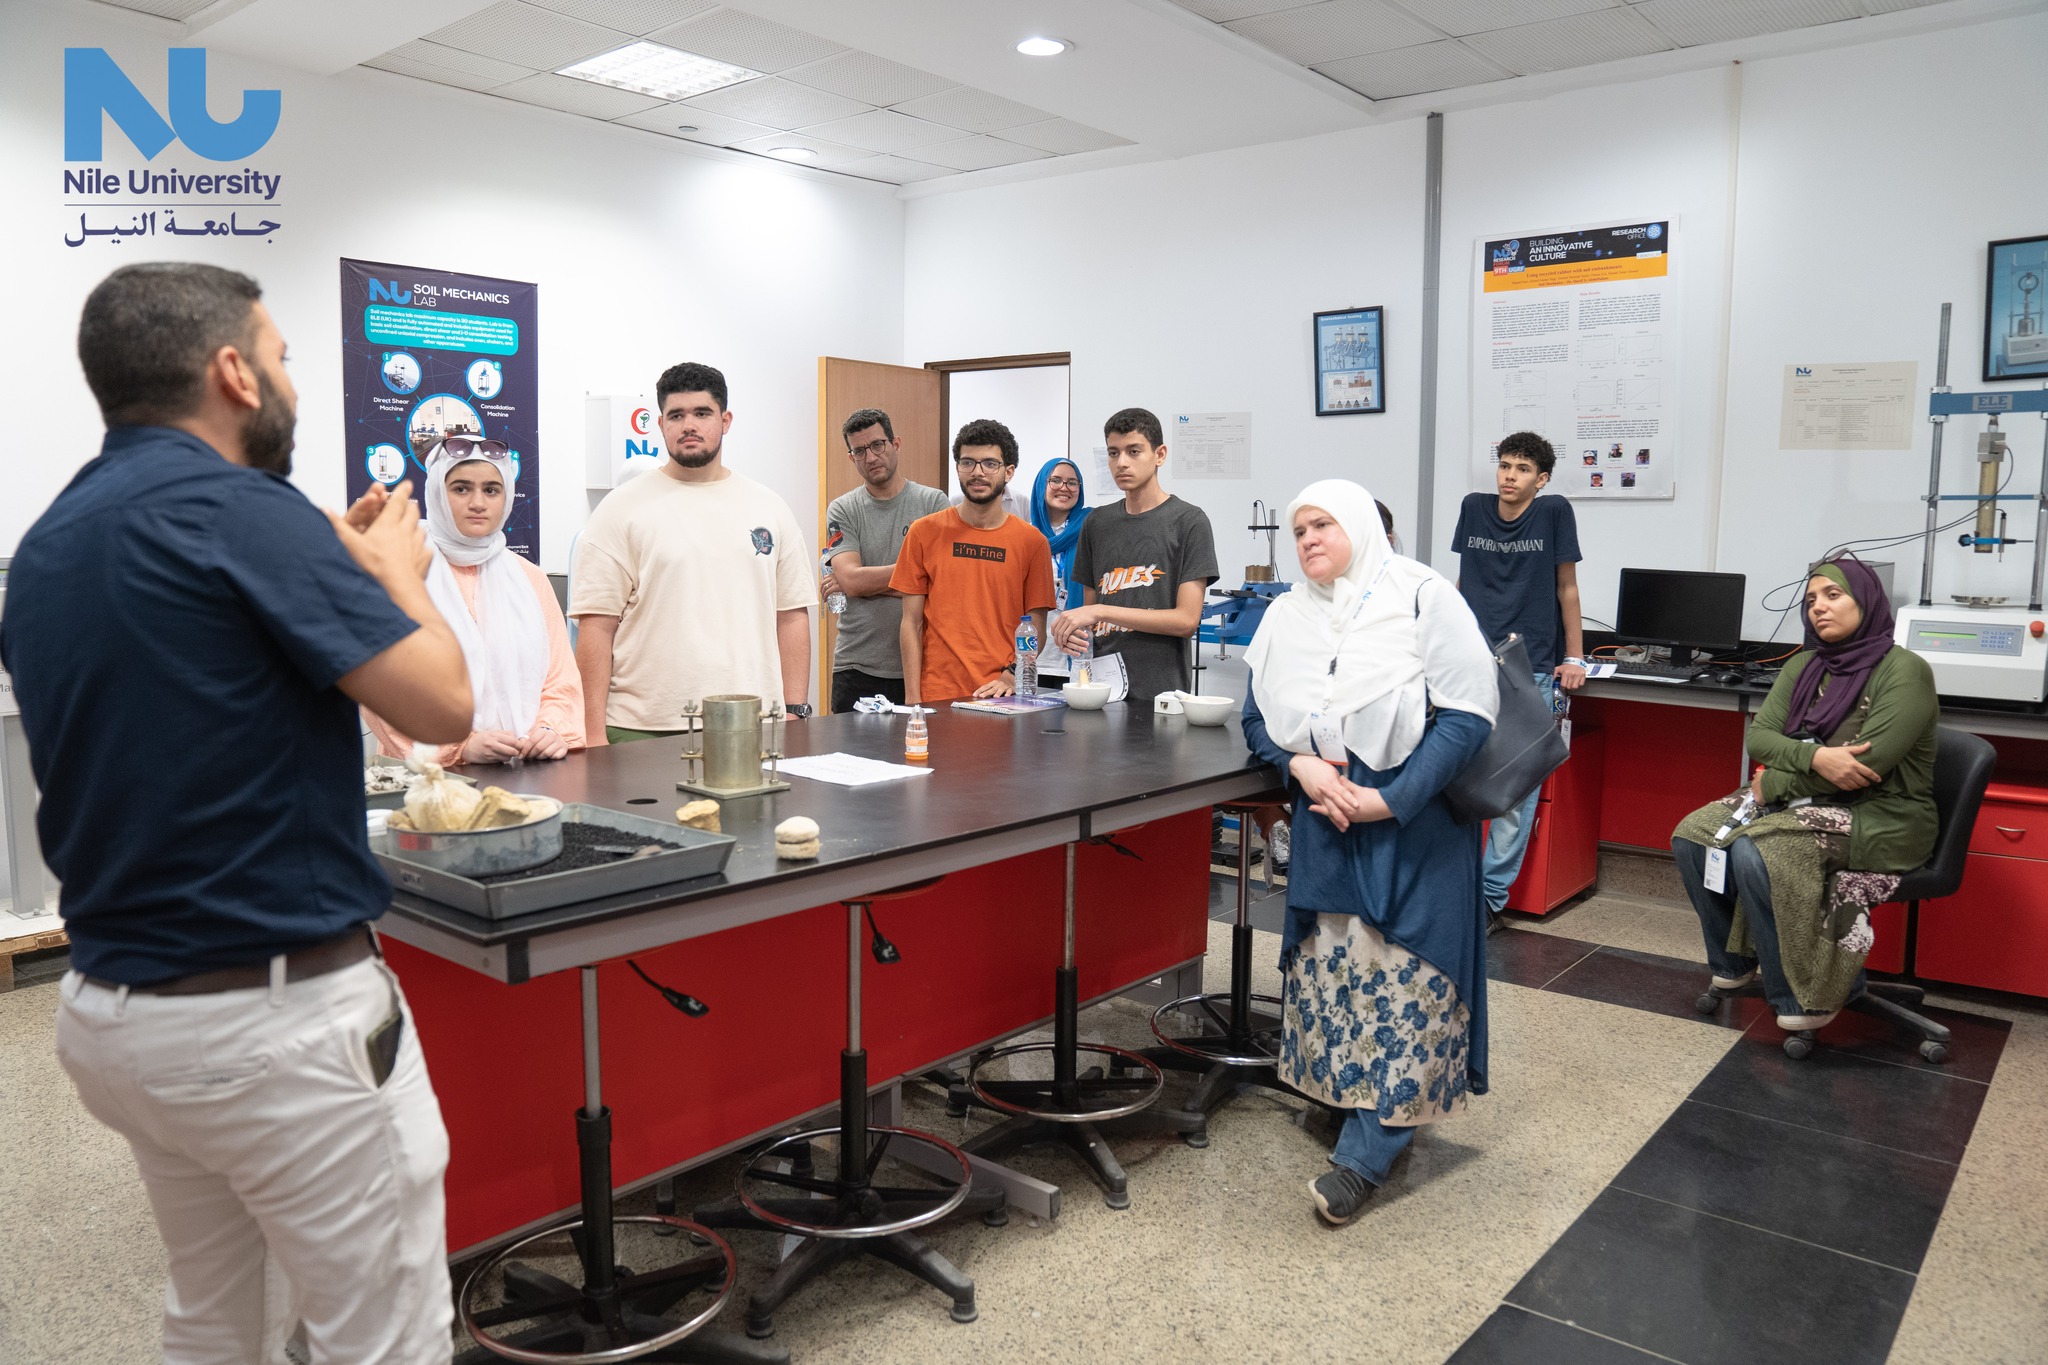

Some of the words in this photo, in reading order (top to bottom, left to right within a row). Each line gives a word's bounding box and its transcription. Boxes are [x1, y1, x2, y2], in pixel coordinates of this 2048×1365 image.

[1612, 227, 1646, 236] RESEARCH
[1530, 237, 1564, 247] BUILDING
[1543, 240, 1593, 252] INNOVATIVE
[1530, 252, 1566, 262] CULTURE
[369, 278, 412, 304] NU
[414, 284, 440, 297] SOIL
[442, 286, 510, 304] MECHANICS
[414, 296, 436, 307] LAB
[1978, 396, 2007, 406] ELE
[626, 439, 658, 459] NU
[1468, 536, 1500, 552] EMPORIO
[1511, 539, 1544, 552] ARMANI
[980, 548, 1003, 560] Fine
[1101, 564, 1157, 595] RULES
